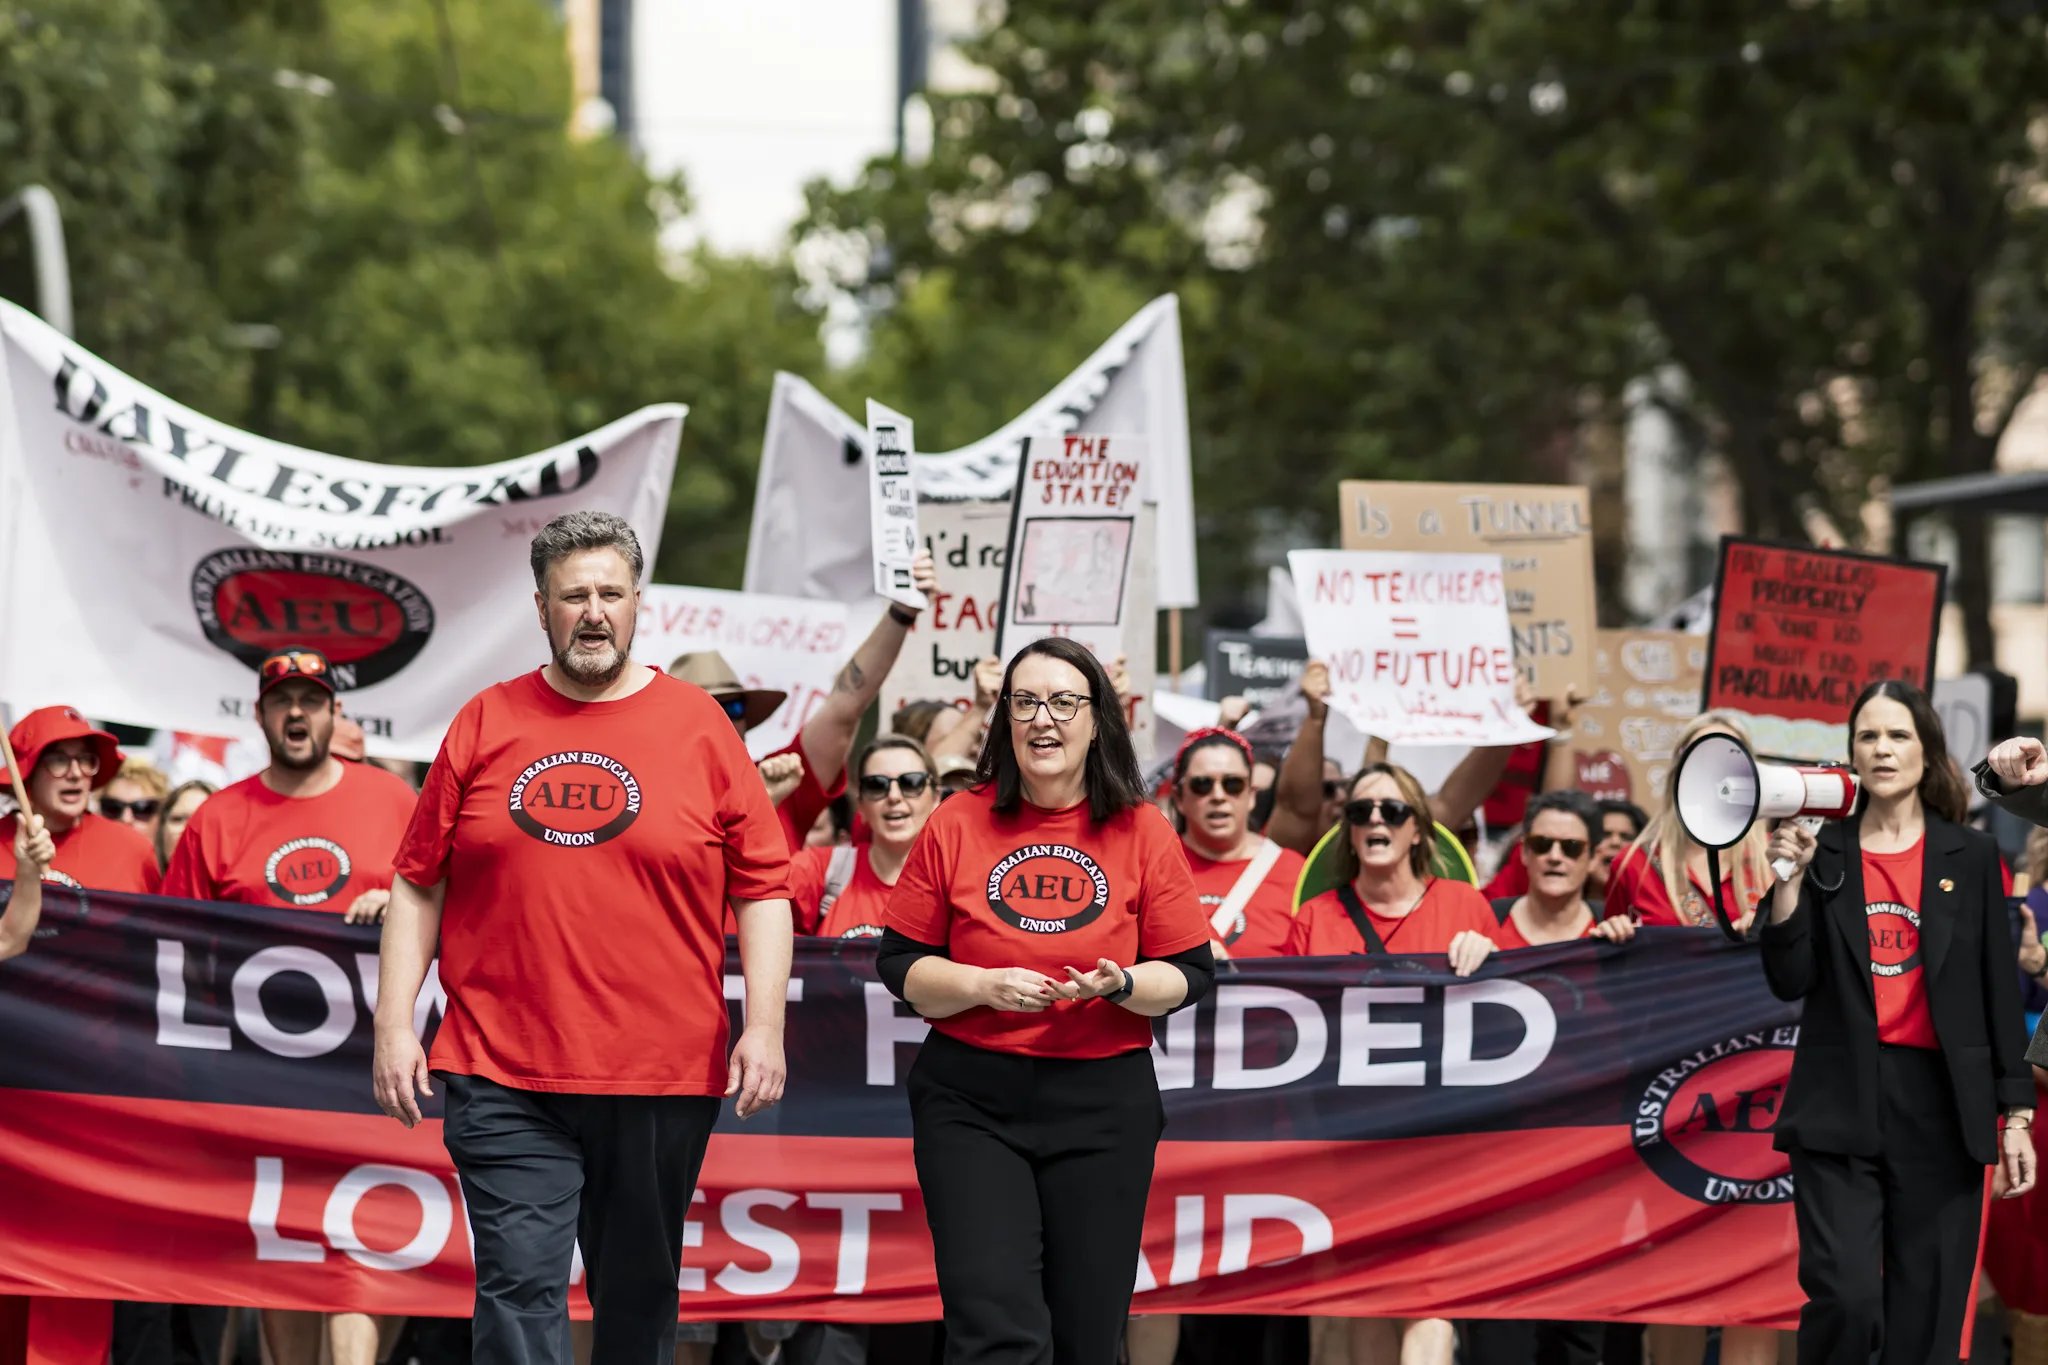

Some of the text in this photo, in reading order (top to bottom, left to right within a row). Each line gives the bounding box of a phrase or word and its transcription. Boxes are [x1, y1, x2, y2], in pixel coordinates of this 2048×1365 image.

[1064, 436, 1109, 458] THE
[1419, 508, 1443, 535] a
[1315, 570, 1355, 604] NO
[1364, 570, 1502, 606] TEACHERS
[230, 592, 386, 637] AEU
[1329, 648, 1365, 684] NO
[1374, 644, 1512, 689] FUTURE
[509, 752, 641, 814] AUSTRALIAN EDUCATION
[526, 781, 620, 812] AEU
[543, 828, 596, 847] UNION
[988, 845, 1109, 907] AUSTRALIAN EDUCATION
[1004, 874, 1089, 903] AEU
[1019, 916, 1067, 933] UNION
[1868, 928, 1914, 951] AEU
[1870, 961, 1903, 977] UNION
[1635, 1031, 1765, 1148] AUSTRALIAN
[1704, 1174, 1795, 1202] UNION
